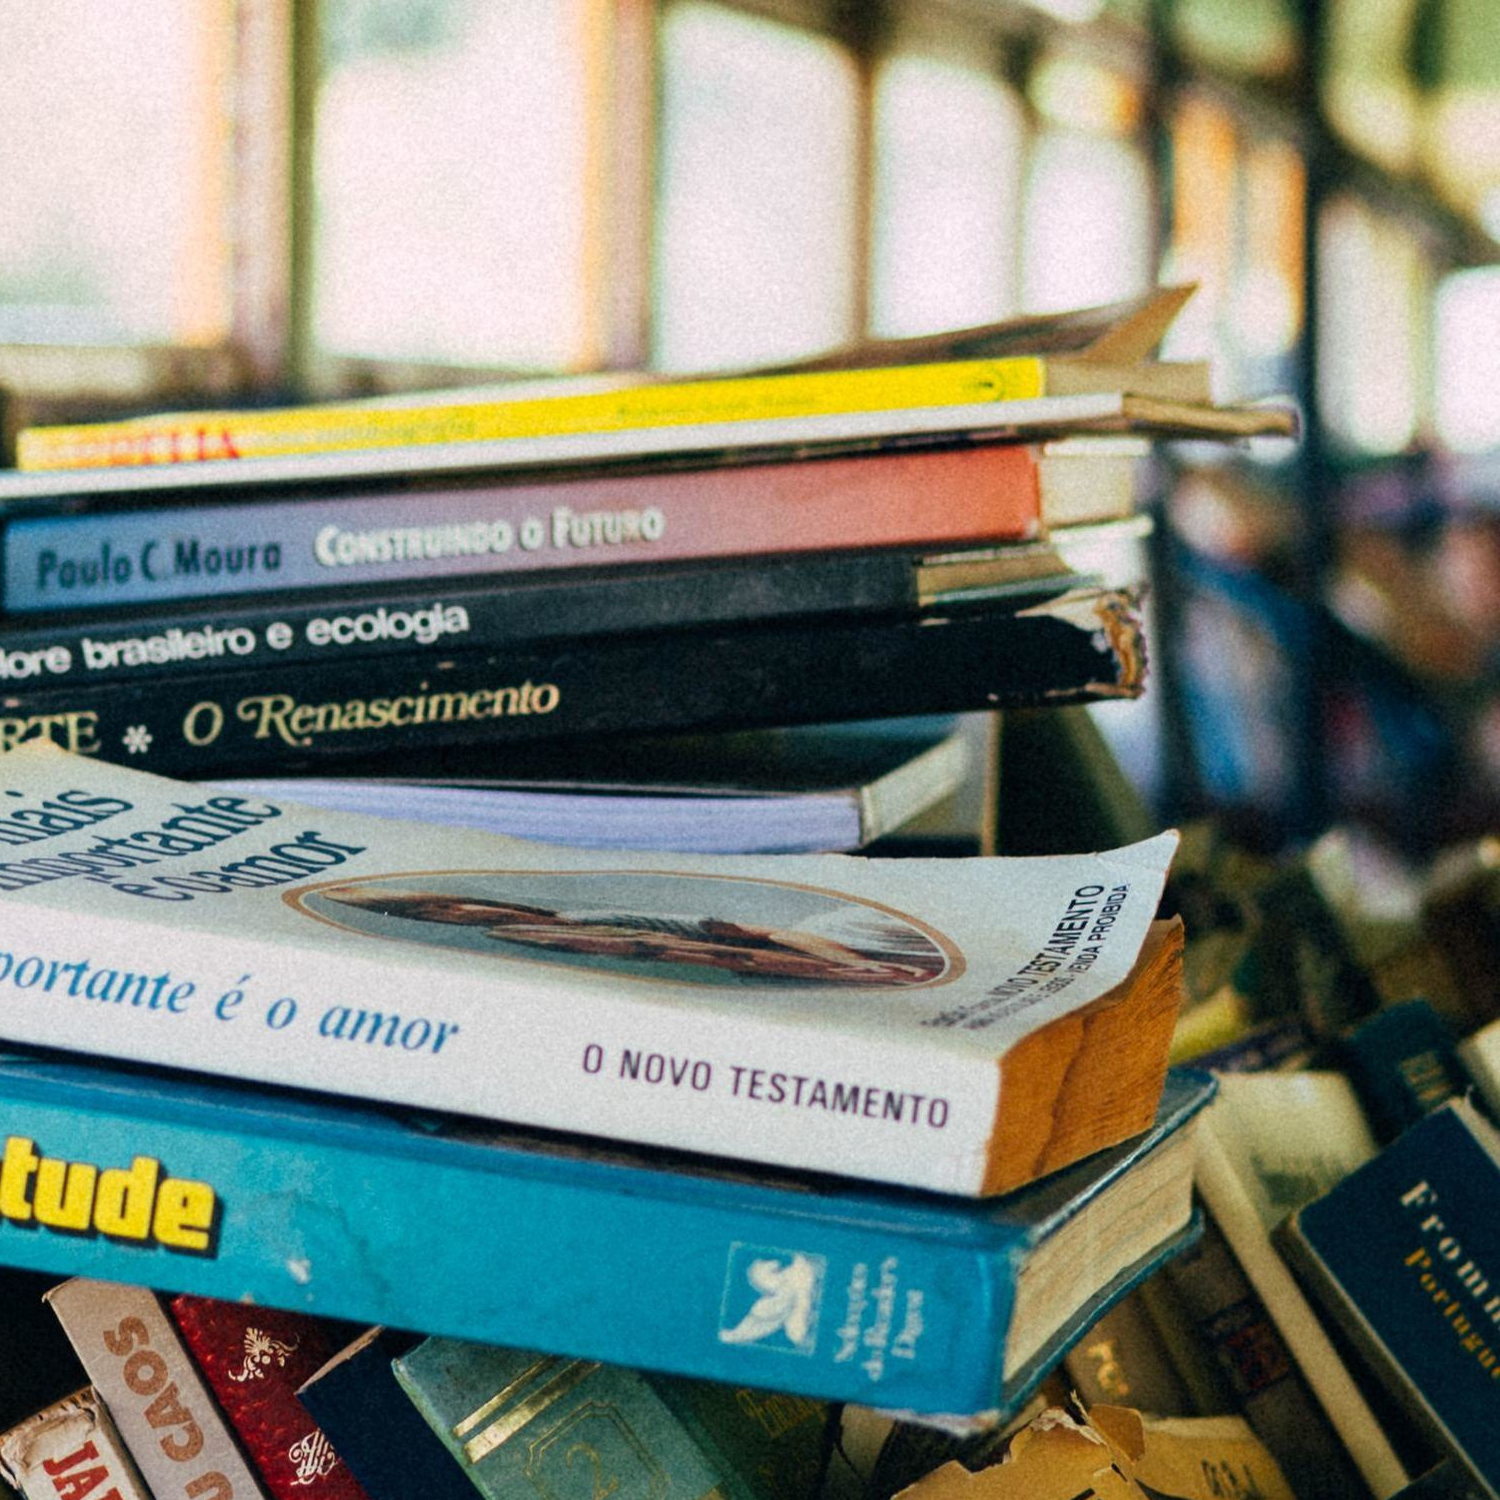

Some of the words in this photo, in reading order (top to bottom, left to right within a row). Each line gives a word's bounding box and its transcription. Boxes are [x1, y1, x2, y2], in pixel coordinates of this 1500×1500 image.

[36, 538, 132, 588] Paulo
[174, 535, 281, 576] Moura
[83, 624, 255, 671] brasileiro
[267, 620, 292, 650] e
[306, 602, 470, 650] ecologia
[183, 702, 223, 746] O
[237, 680, 560, 746] Renascimento
[216, 830, 367, 888] amor
[1017, 884, 1105, 977] TESTAMENTO
[215, 975, 253, 1022] é
[266, 996, 298, 1031] o
[318, 1001, 460, 1055] amor
[583, 1043, 602, 1074] O
[618, 1048, 712, 1092] NOVO
[730, 1065, 951, 1129] TESTAMENTO
[102, 1316, 204, 1463] CAOS
